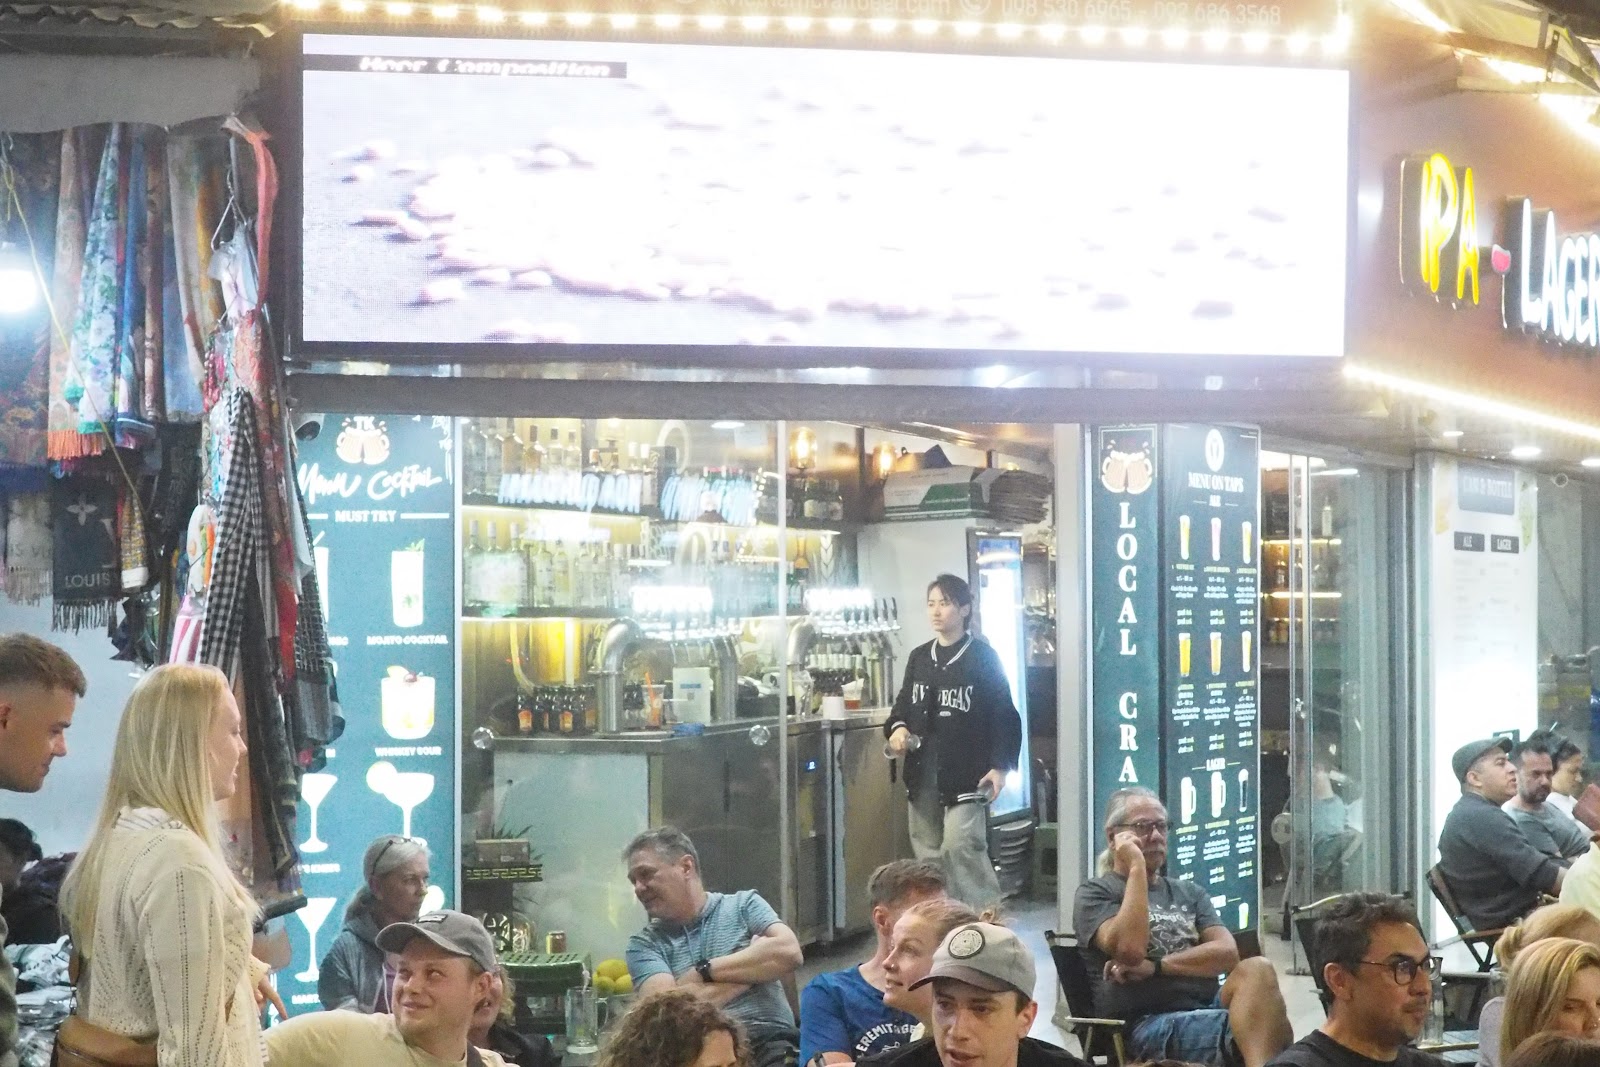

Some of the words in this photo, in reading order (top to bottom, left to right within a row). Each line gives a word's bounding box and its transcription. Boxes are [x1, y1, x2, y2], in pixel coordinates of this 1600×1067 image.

[1420, 153, 1479, 305] IPA
[1521, 198, 1600, 347] LAGER
[65, 574, 112, 588] LOUIS
[335, 510, 370, 523] MUST
[371, 510, 397, 523] TRY
[1116, 502, 1139, 656] LOCAL
